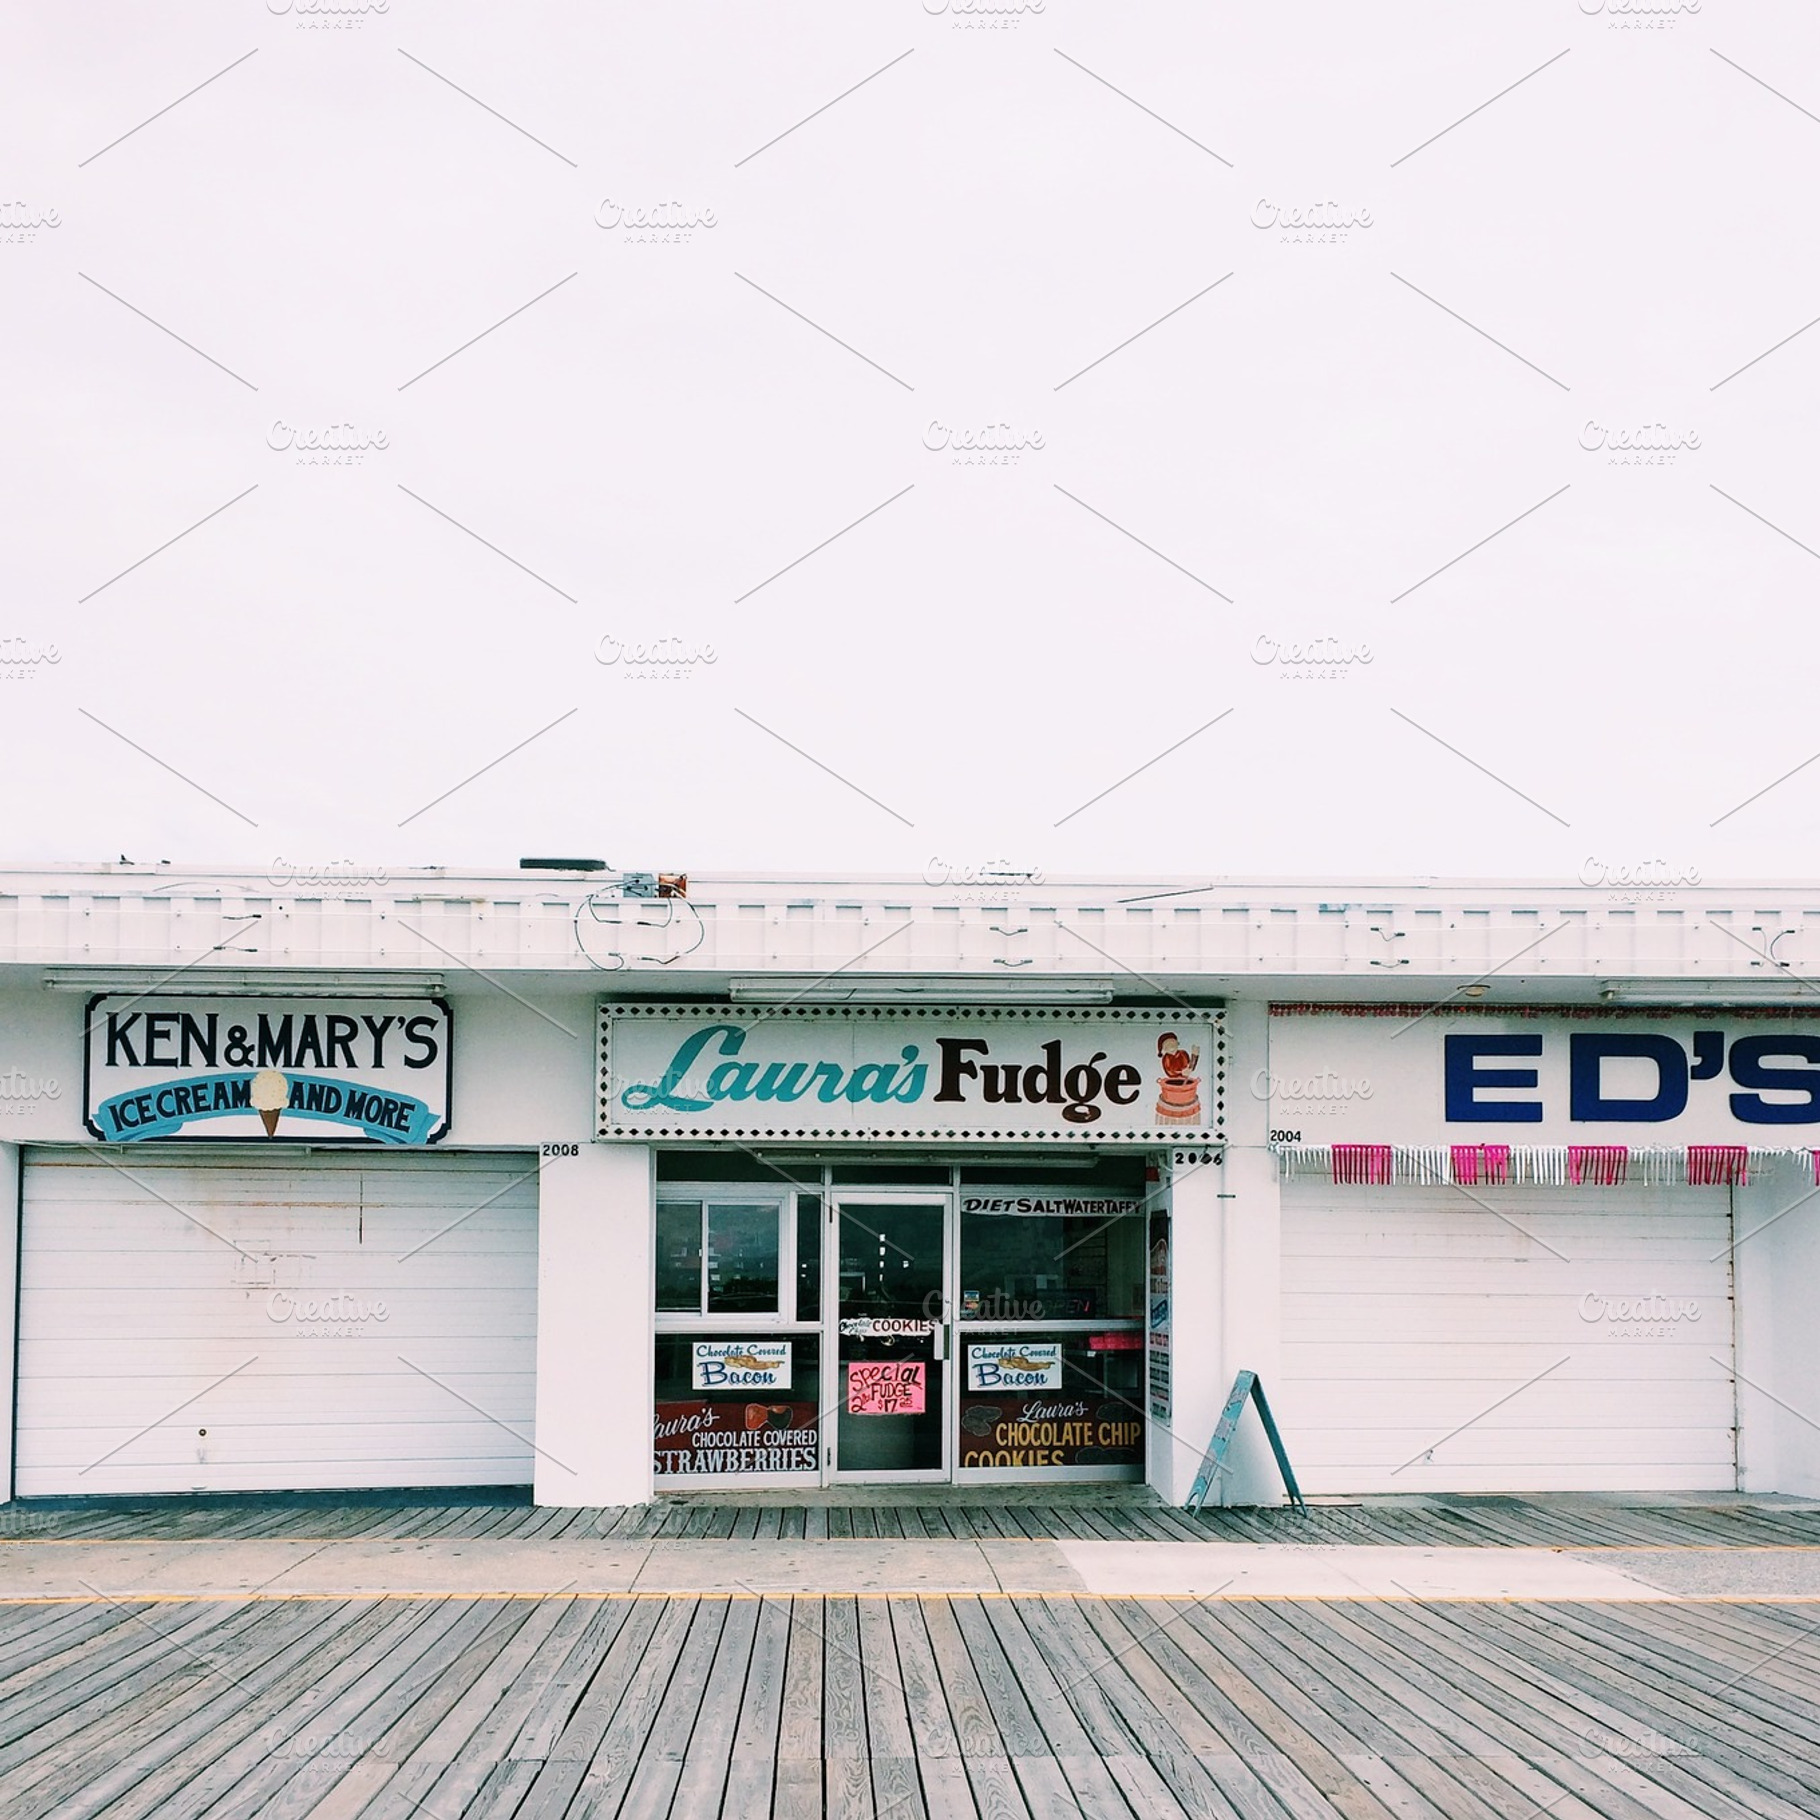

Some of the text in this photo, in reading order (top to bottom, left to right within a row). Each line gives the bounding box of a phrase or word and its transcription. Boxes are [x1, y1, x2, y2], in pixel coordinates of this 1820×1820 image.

[621, 1025, 1142, 1124] Laura's Fudge
[1445, 1031, 1820, 1125] ED'S
[287, 1081, 342, 1114] AND
[343, 1089, 416, 1133] MORE
[1270, 1130, 1301, 1142] 2004
[543, 1144, 579, 1156] 2008
[963, 1199, 1015, 1212] DIET
[1062, 1199, 1105, 1214] WATER
[873, 1319, 935, 1332] COOKIES
[697, 1344, 786, 1357] Chocolate Covered
[972, 1345, 1056, 1359] Chocolate Covered
[697, 1361, 777, 1386] Bacon
[972, 1363, 1048, 1388] Bacon
[871, 1382, 912, 1400] FUDGE
[1016, 1400, 1089, 1423] Laura's
[691, 1429, 818, 1448] CHOCOLATE COVERED
[995, 1422, 1142, 1447] CHOCOLATE CHIP
[654, 1446, 817, 1474] STRAWBERRIES
[964, 1449, 1065, 1467] COOKIES
